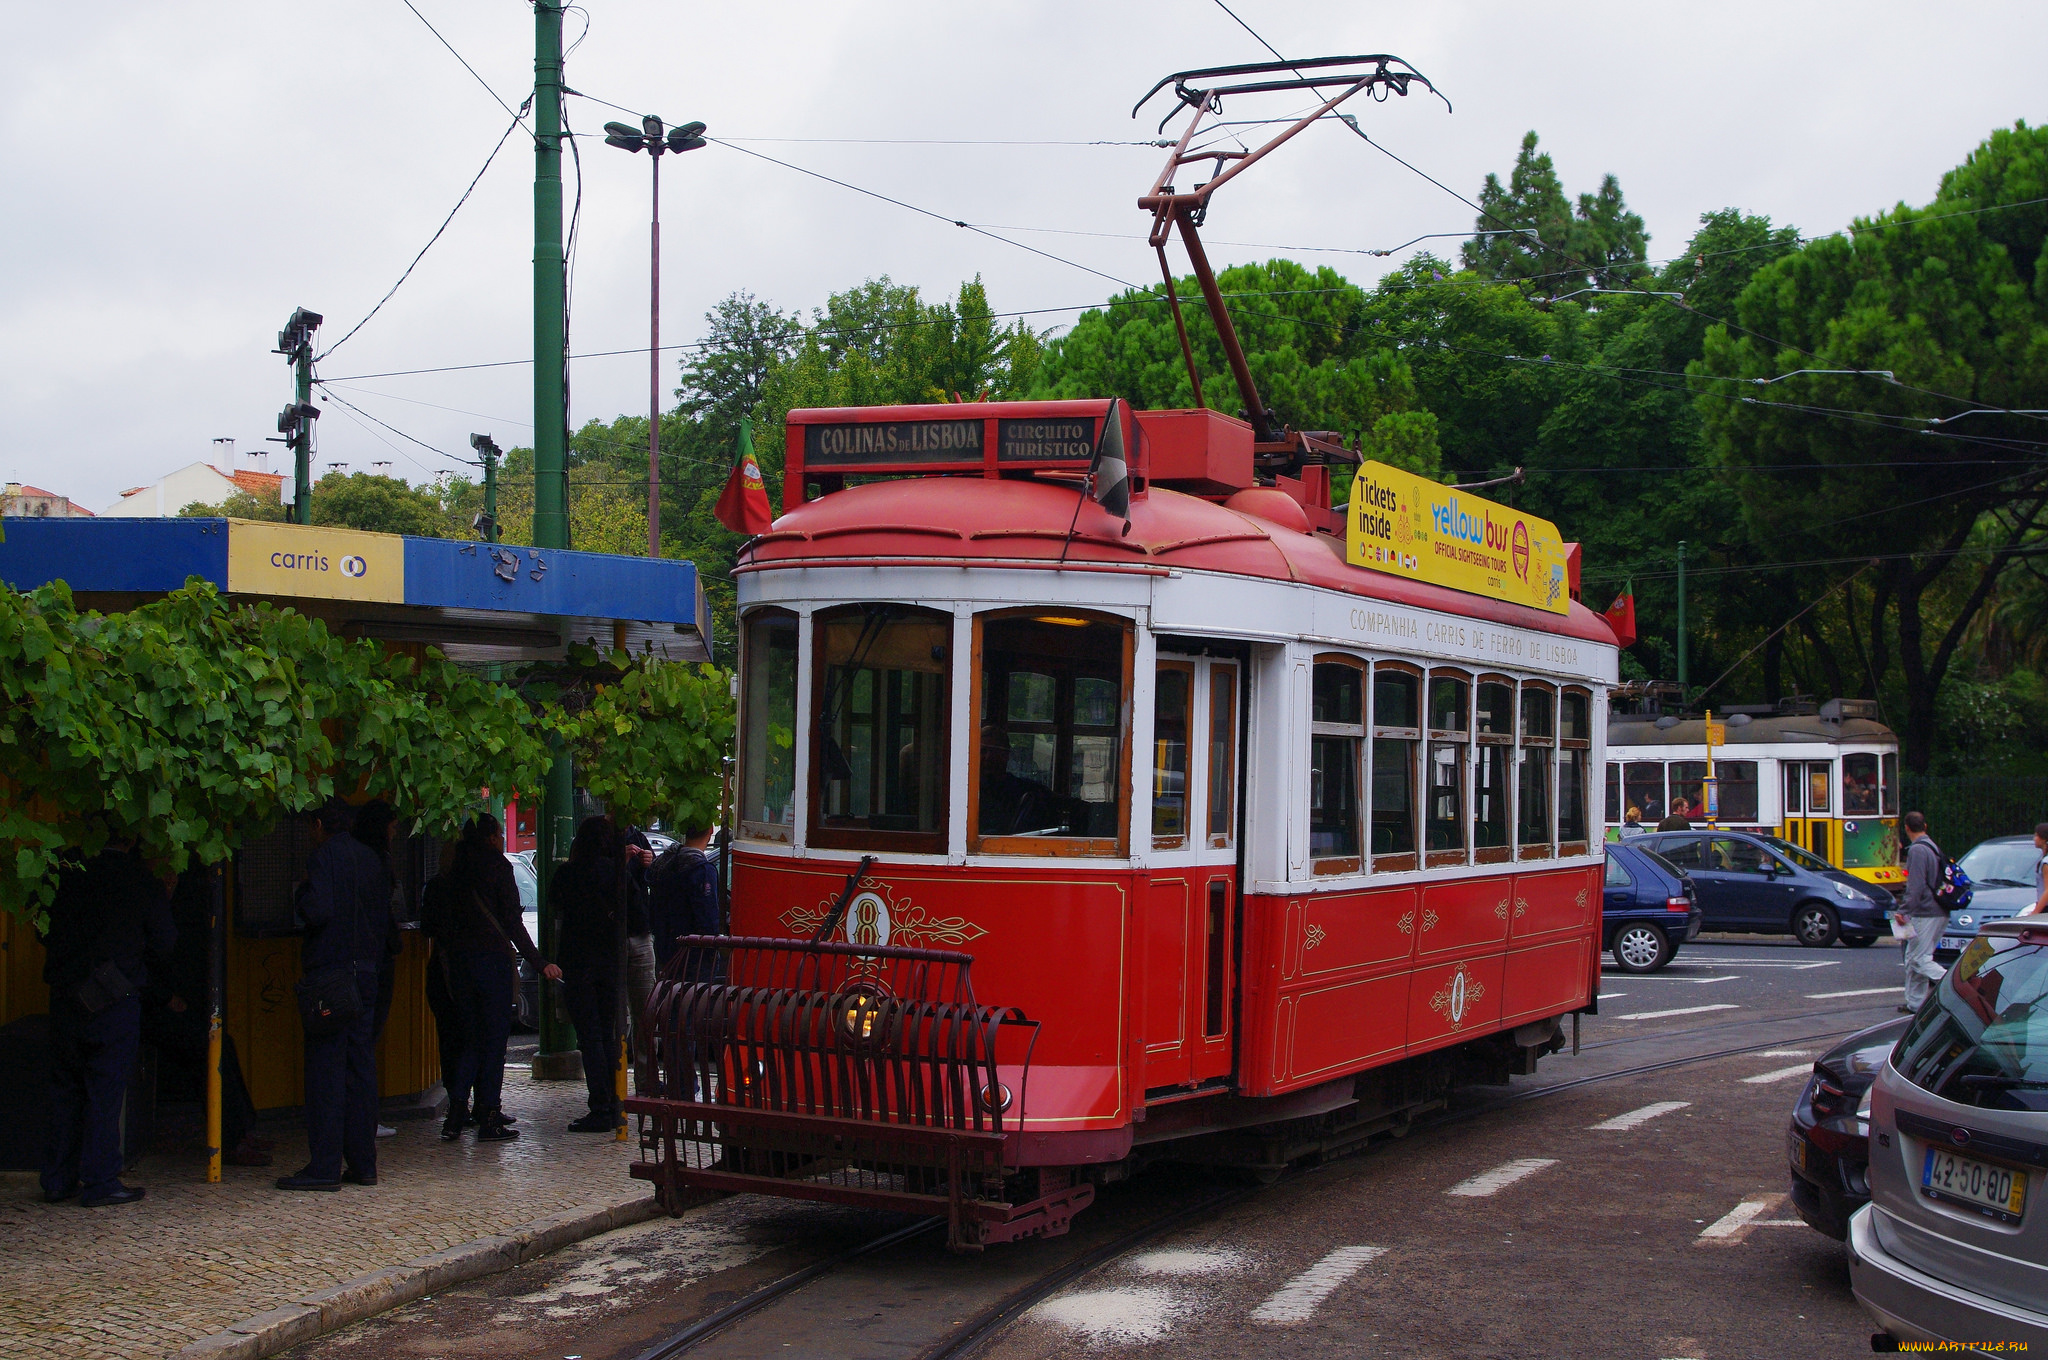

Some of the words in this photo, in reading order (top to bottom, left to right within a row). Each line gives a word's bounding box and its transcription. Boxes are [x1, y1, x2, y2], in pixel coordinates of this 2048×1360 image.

[821, 426, 897, 455] COLINAS
[900, 439, 911, 451] DE
[912, 422, 979, 451] LISBOA
[1005, 440, 1090, 456] TURÍSTICO
[1008, 425, 1083, 439] CIRCUITO
[1358, 475, 1396, 512] Tickets
[1359, 505, 1391, 540] inside
[1485, 509, 1508, 552] bus
[271, 549, 329, 572] carris
[1434, 541, 1458, 561] OFFICIAL
[1458, 548, 1490, 569] SIGHTSEEING
[1491, 557, 1507, 574] TOURS
[1350, 607, 1418, 639] COMPANHIA
[1426, 622, 1465, 646] CARRIS
[1472, 630, 1484, 650] DE
[1491, 634, 1522, 656] FERRO
[1530, 641, 1541, 660] DE
[1546, 644, 1578, 666] LISBOA
[852, 898, 882, 946] 8
